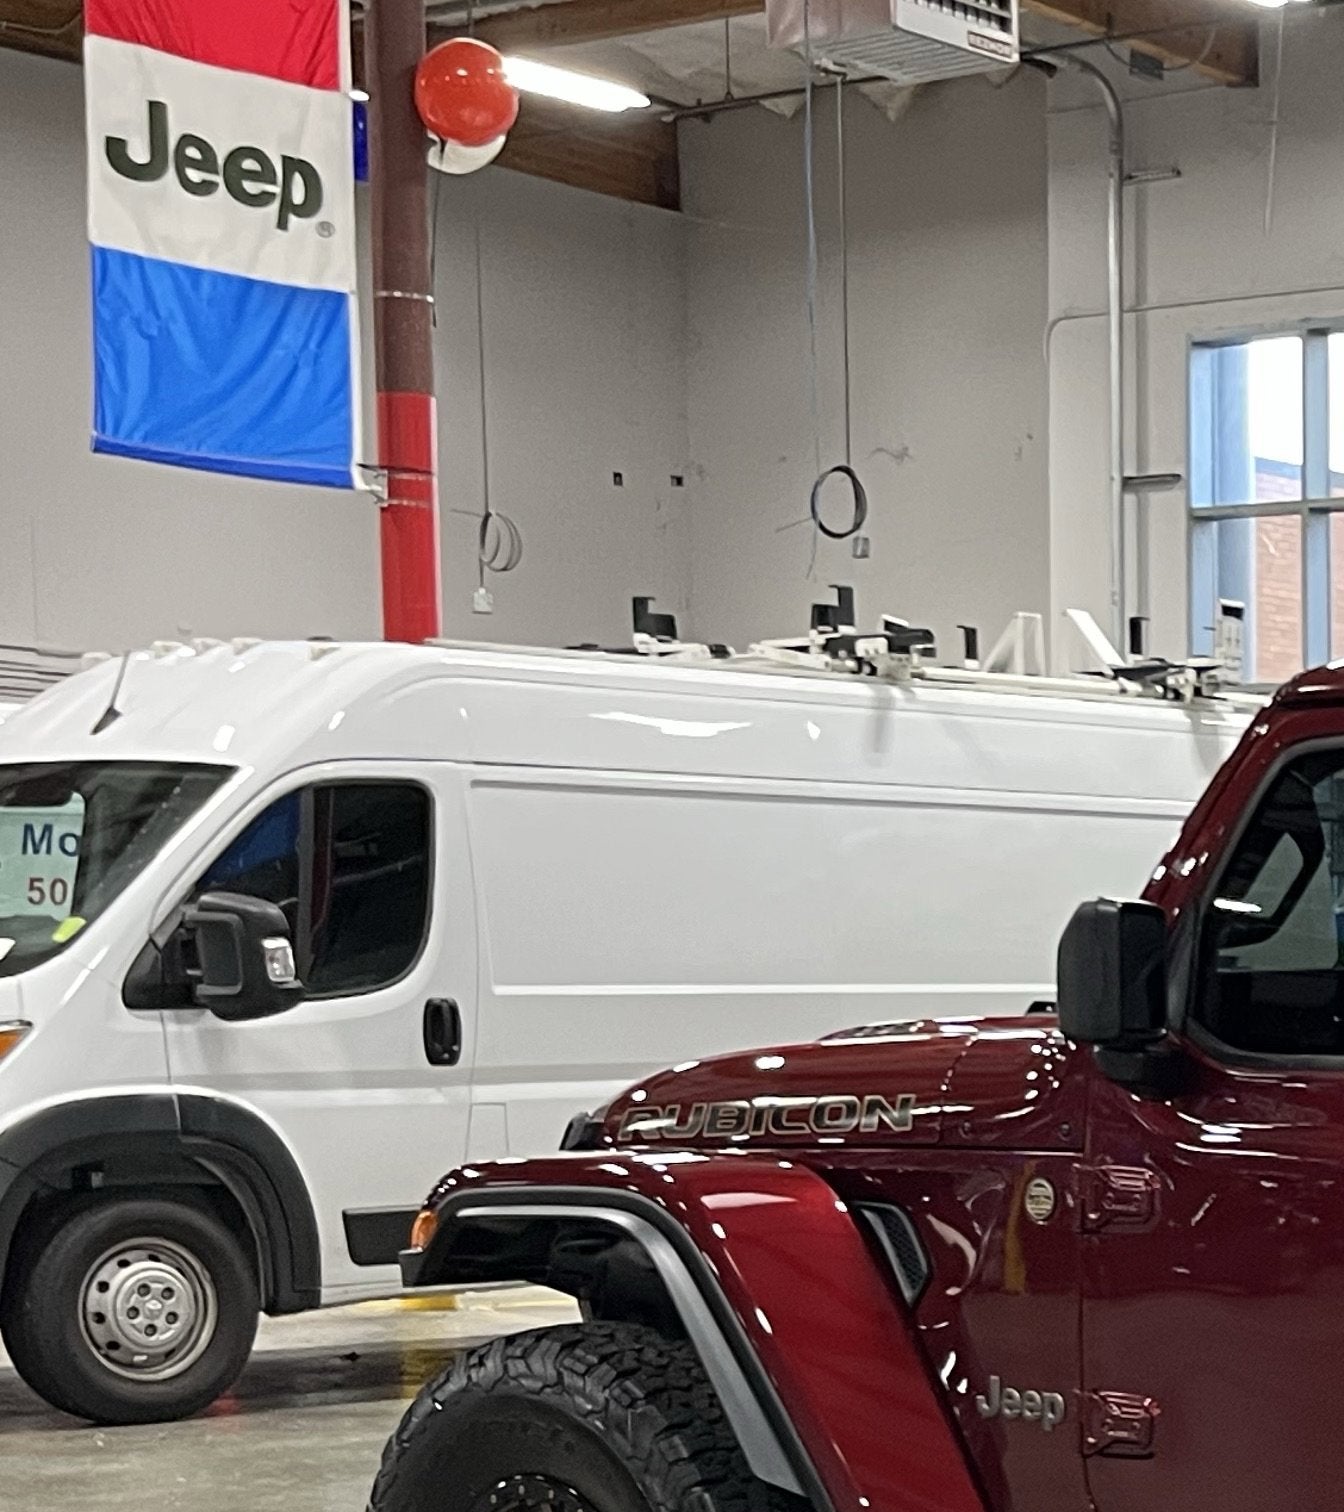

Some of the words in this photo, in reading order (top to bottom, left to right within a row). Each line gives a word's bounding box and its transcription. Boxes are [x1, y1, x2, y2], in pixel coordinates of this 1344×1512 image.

[105, 99, 324, 232] Jeep
[27, 877, 68, 906] 50
[617, 1094, 917, 1142] RUBICON
[975, 1374, 1065, 1432] Jeep
